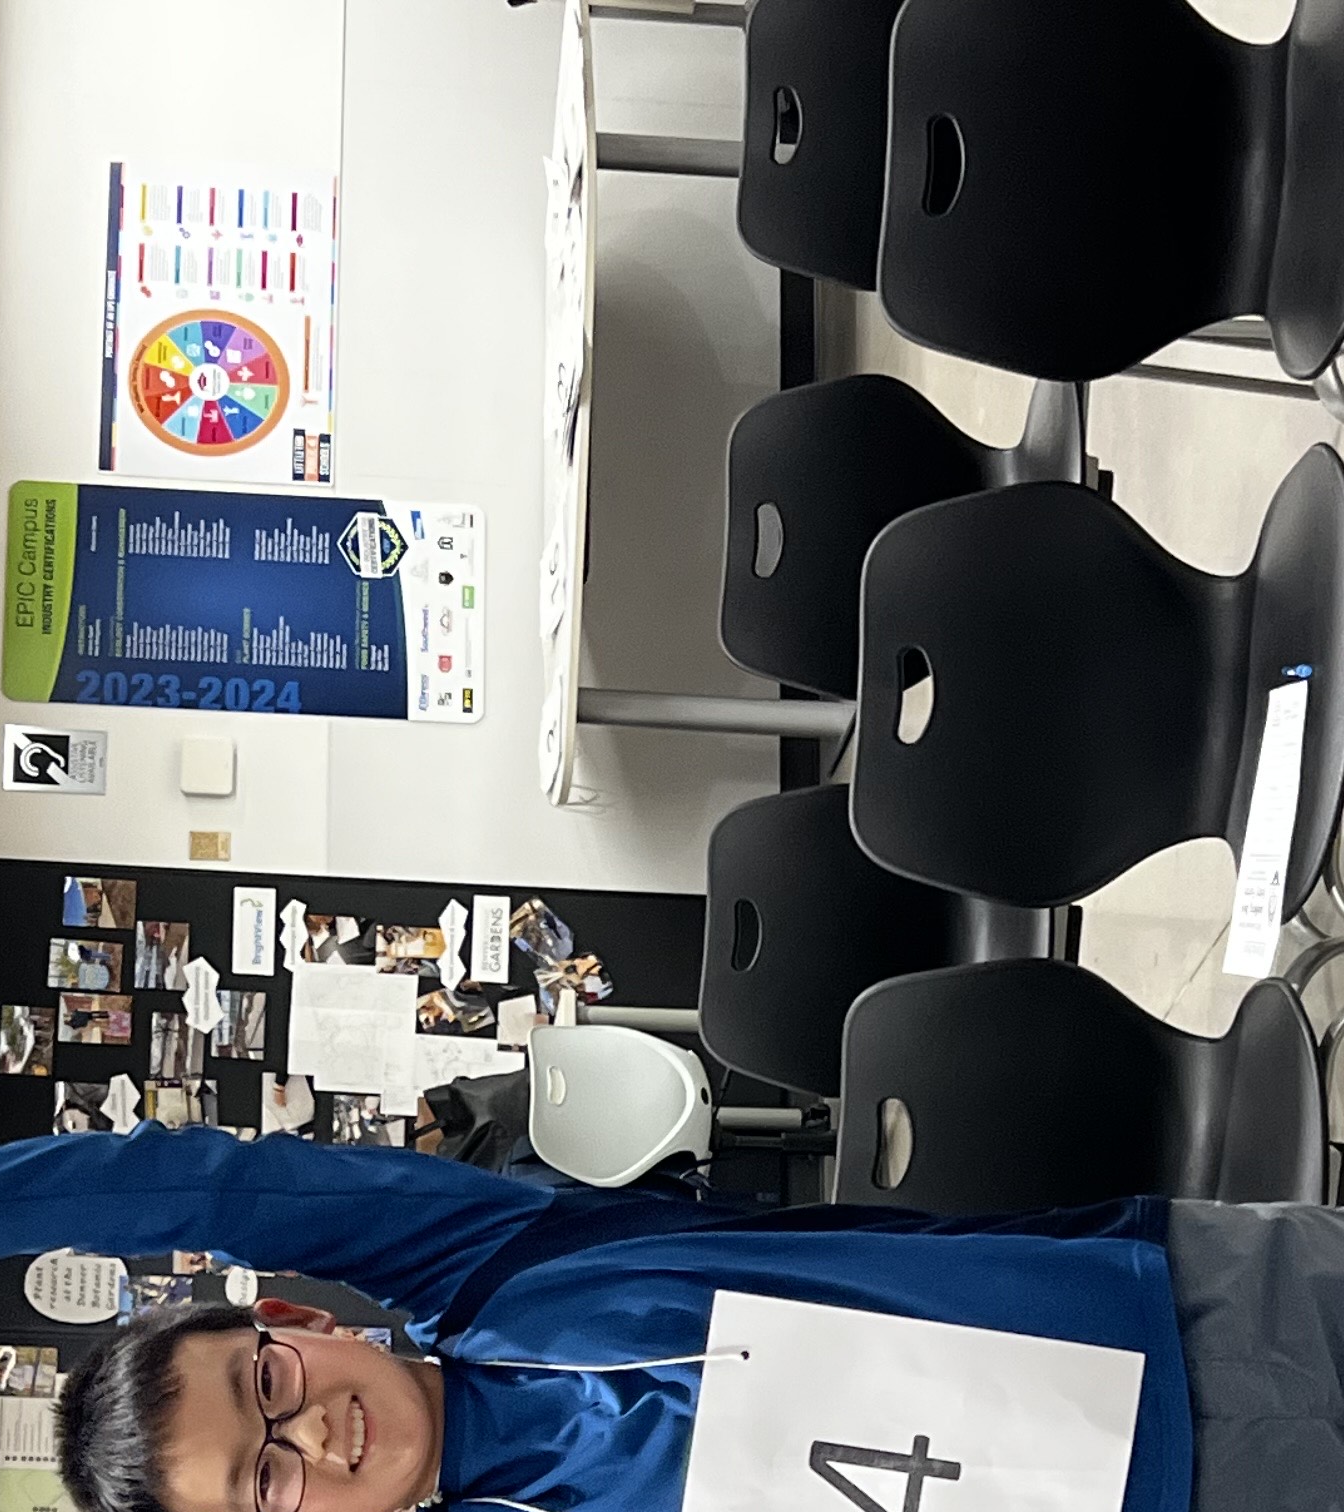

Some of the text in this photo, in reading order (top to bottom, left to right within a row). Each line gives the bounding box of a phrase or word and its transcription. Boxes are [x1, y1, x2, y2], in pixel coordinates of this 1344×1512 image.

[15, 498, 41, 628] EPIC Campus
[41, 499, 56, 635] INDUSTRY CERTIFICATIONS
[76, 669, 303, 714] 2023-2024
[251, 909, 264, 966] BrightView
[488, 907, 504, 973] GARDENS
[32, 1265, 43, 1300] Plant
[49, 1258, 59, 1310] research
[76, 1263, 87, 1307] Denver
[105, 1262, 117, 1311] Gardens
